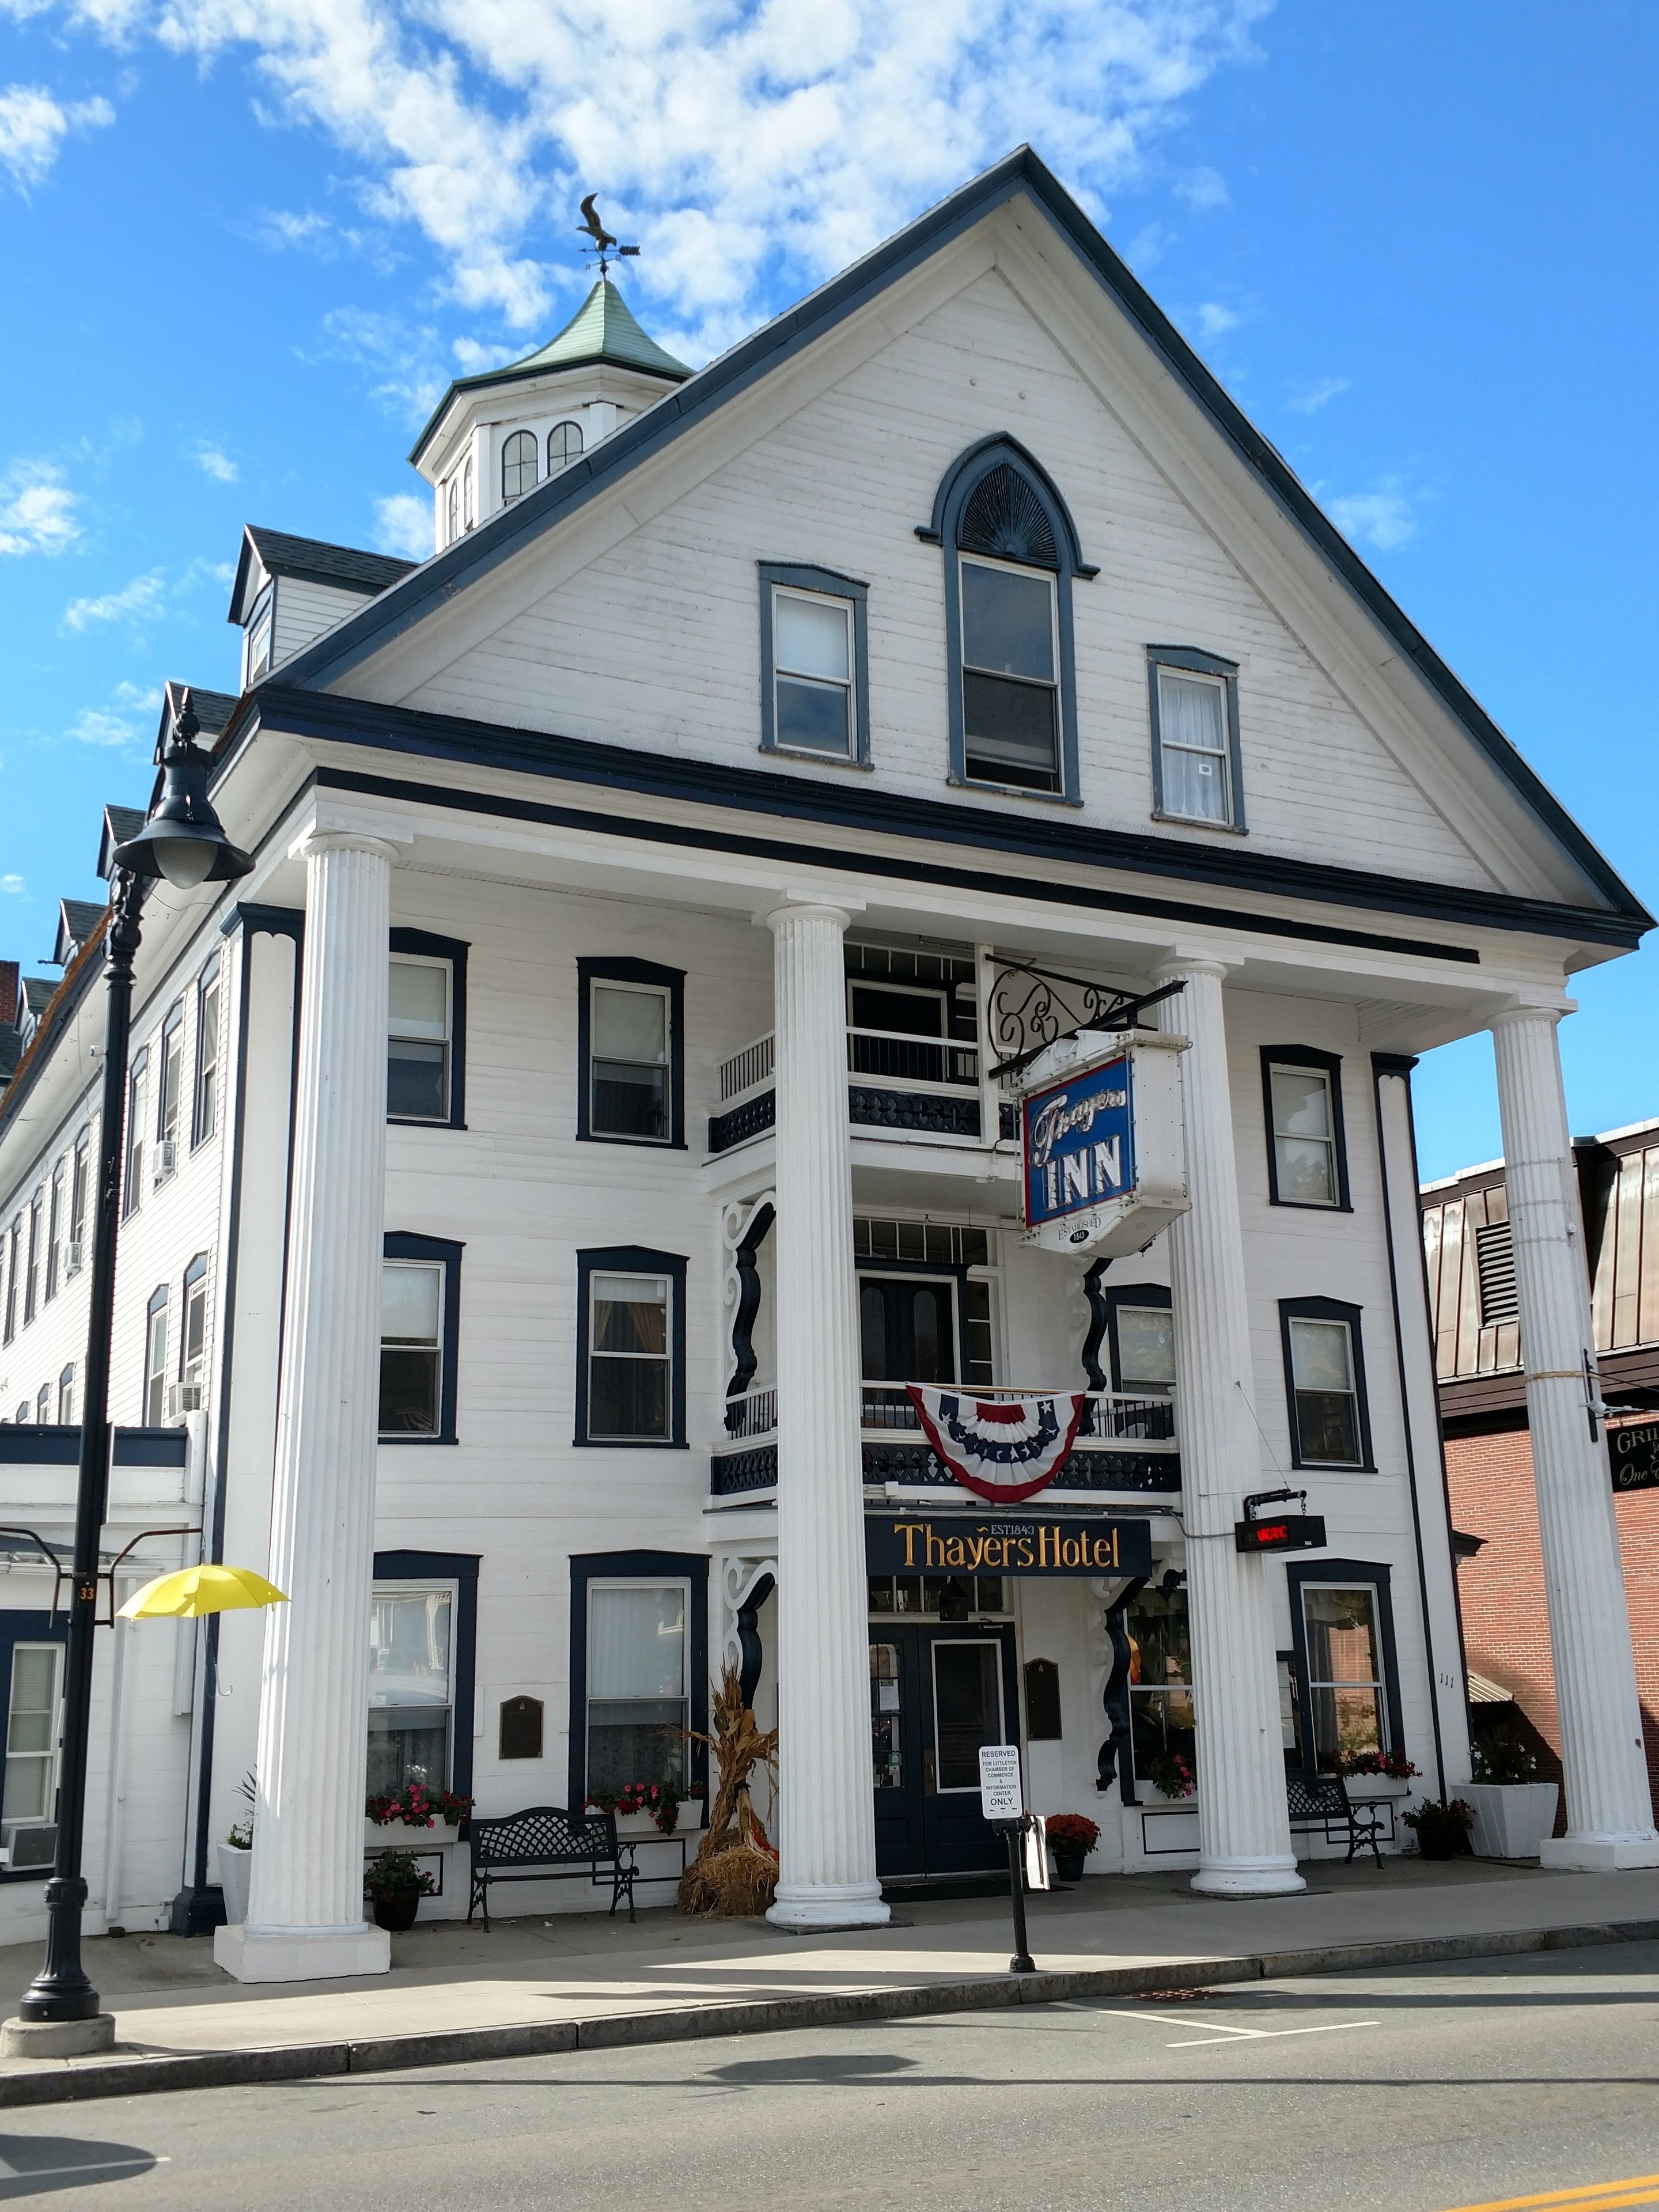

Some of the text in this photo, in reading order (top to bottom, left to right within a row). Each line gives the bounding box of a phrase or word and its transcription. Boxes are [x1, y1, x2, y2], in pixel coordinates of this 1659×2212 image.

[1046, 1135, 1121, 1211] INN
[1058, 1217, 1101, 1240] ESTABLISHED
[1073, 1231, 1085, 1241] 1843
[1620, 1464, 1647, 1485] One
[1037, 1526, 1120, 1567] Hotel
[80, 1587, 94, 1600] 33
[990, 1797, 1013, 1805] ONLY
